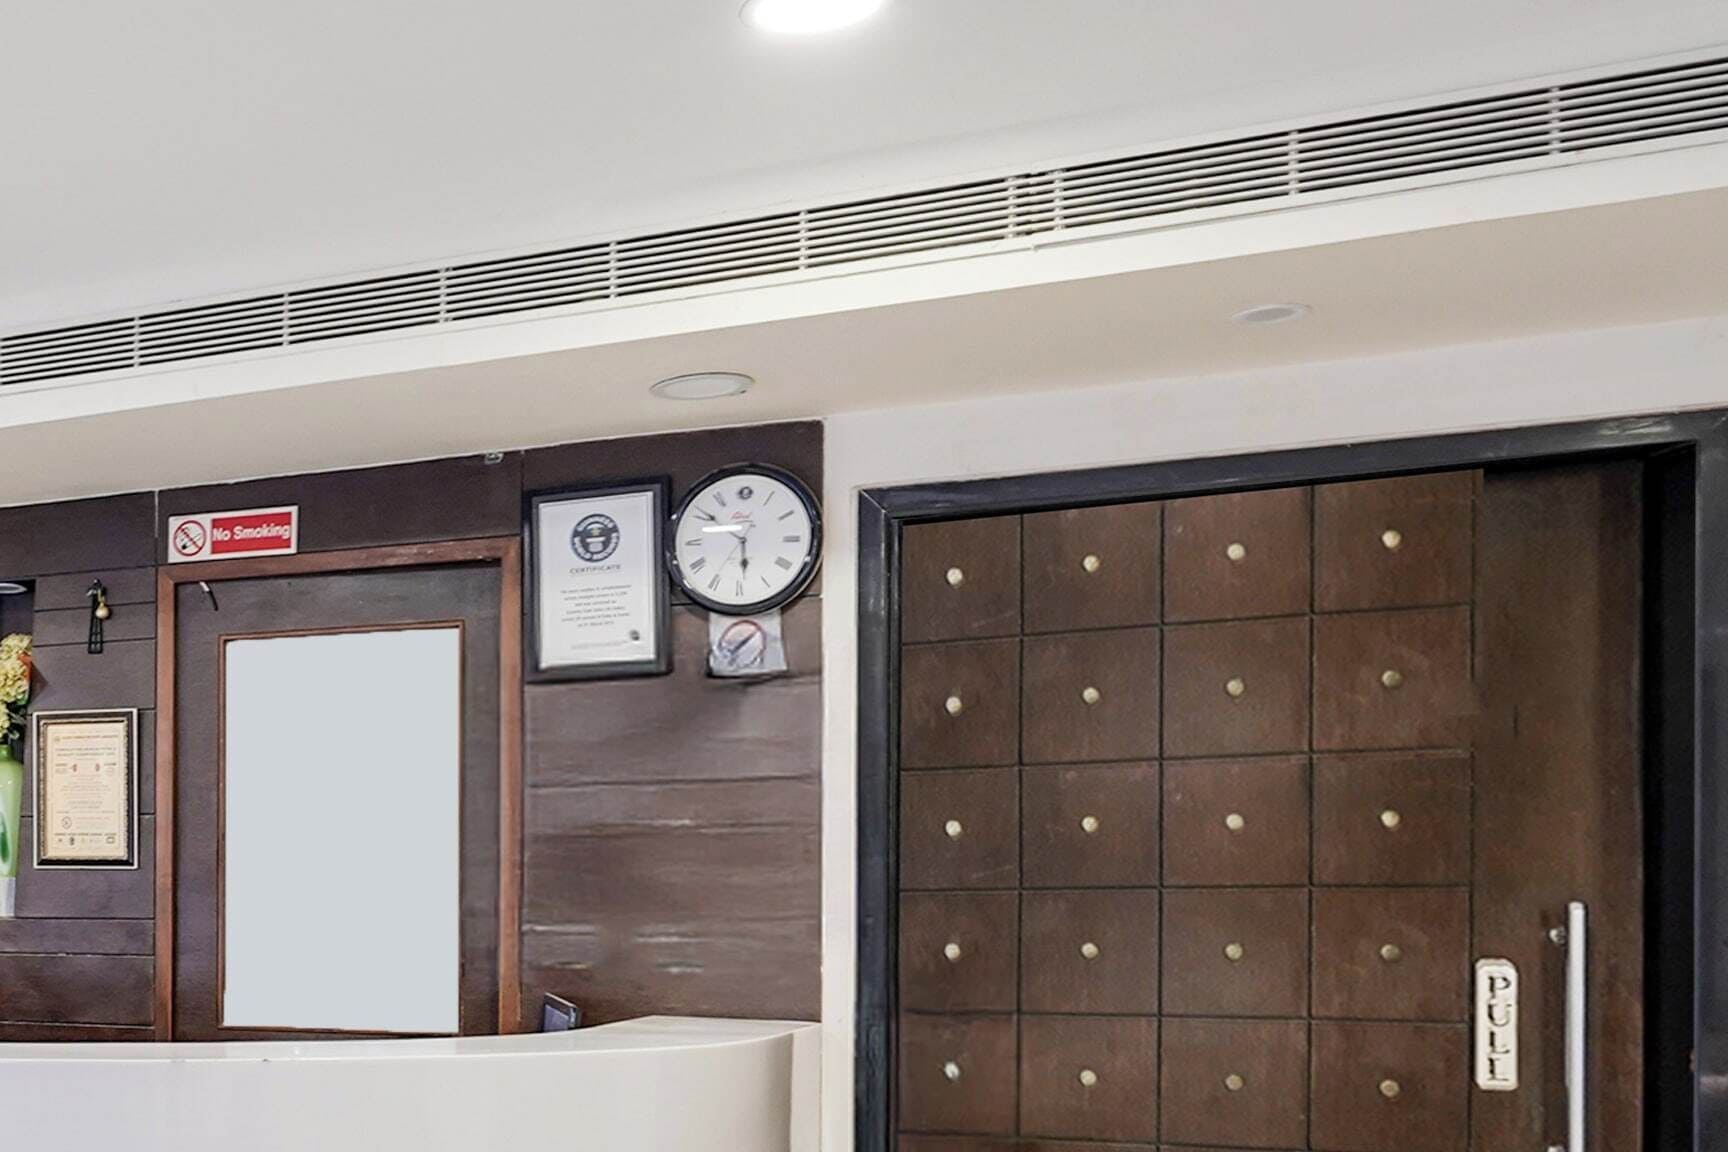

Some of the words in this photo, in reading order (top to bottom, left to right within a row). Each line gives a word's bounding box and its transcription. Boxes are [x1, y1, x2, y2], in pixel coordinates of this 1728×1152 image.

[212, 527, 232, 542] No
[233, 522, 291, 540] Smoking
[569, 564, 622, 574] CERTIFICATE
[1486, 974, 1512, 1083] PULL
